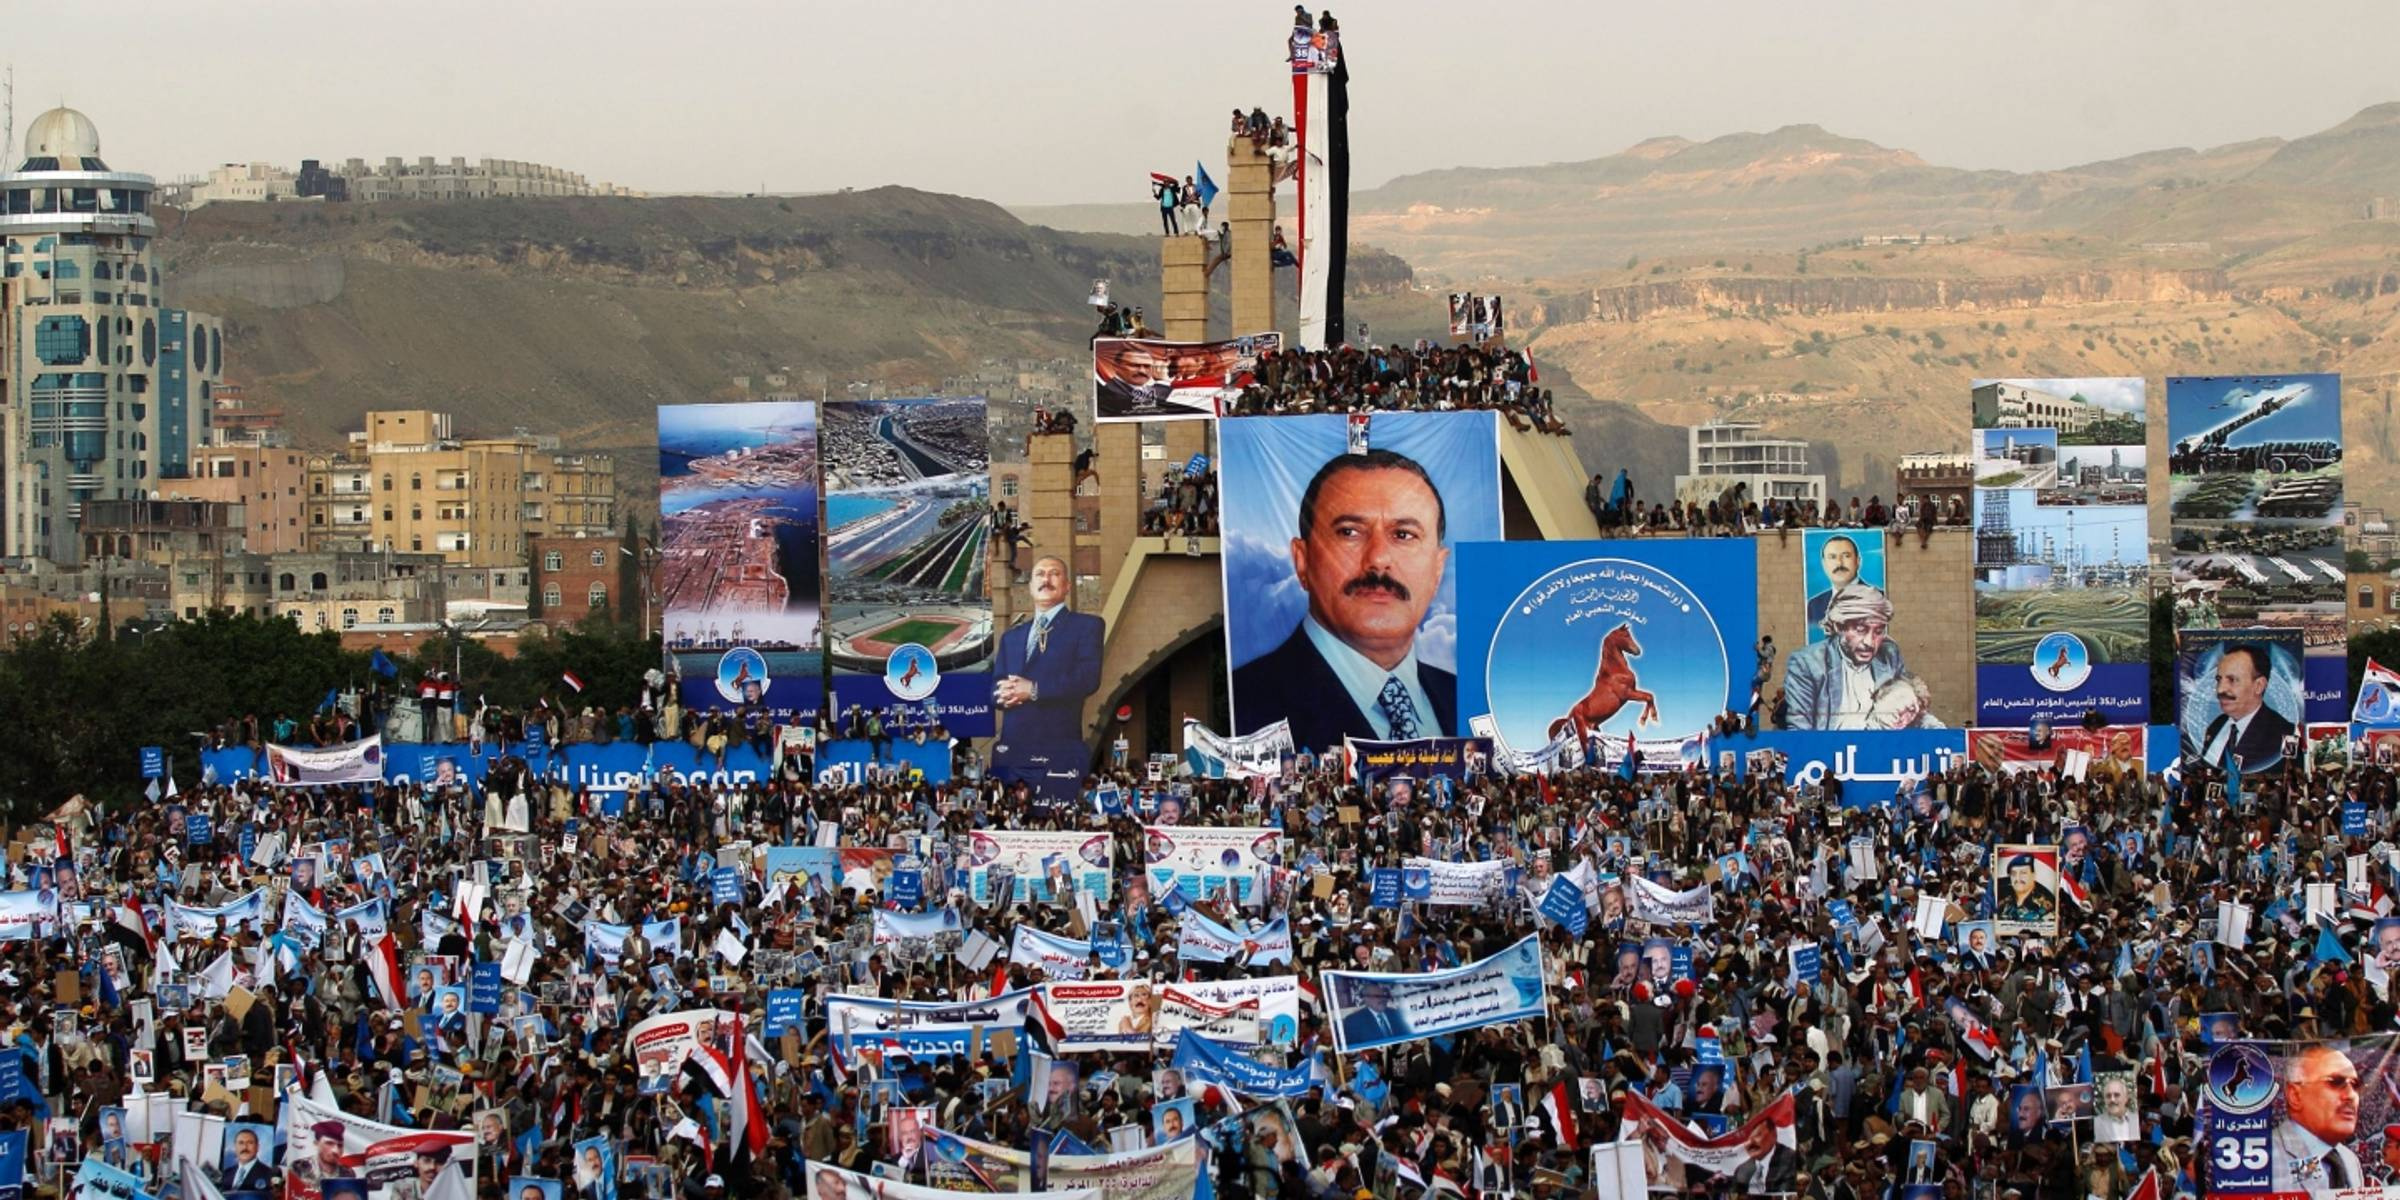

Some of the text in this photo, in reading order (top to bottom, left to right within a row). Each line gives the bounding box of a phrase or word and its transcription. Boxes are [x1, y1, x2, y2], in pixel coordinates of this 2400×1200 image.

[1599, 566, 1615, 579] الله
[1564, 603, 1648, 626] المؤتمر الشعبي العام
[1983, 697, 2004, 711] العام
[2004, 696, 2035, 711] الشعبي
[2036, 696, 2066, 710] المؤتمر
[876, 1007, 1001, 1031] محافظة أبين
[1224, 1057, 1277, 1078] المؤتمر
[2226, 1118, 2267, 1133] الذكرى
[2214, 1136, 2270, 1171] 35
